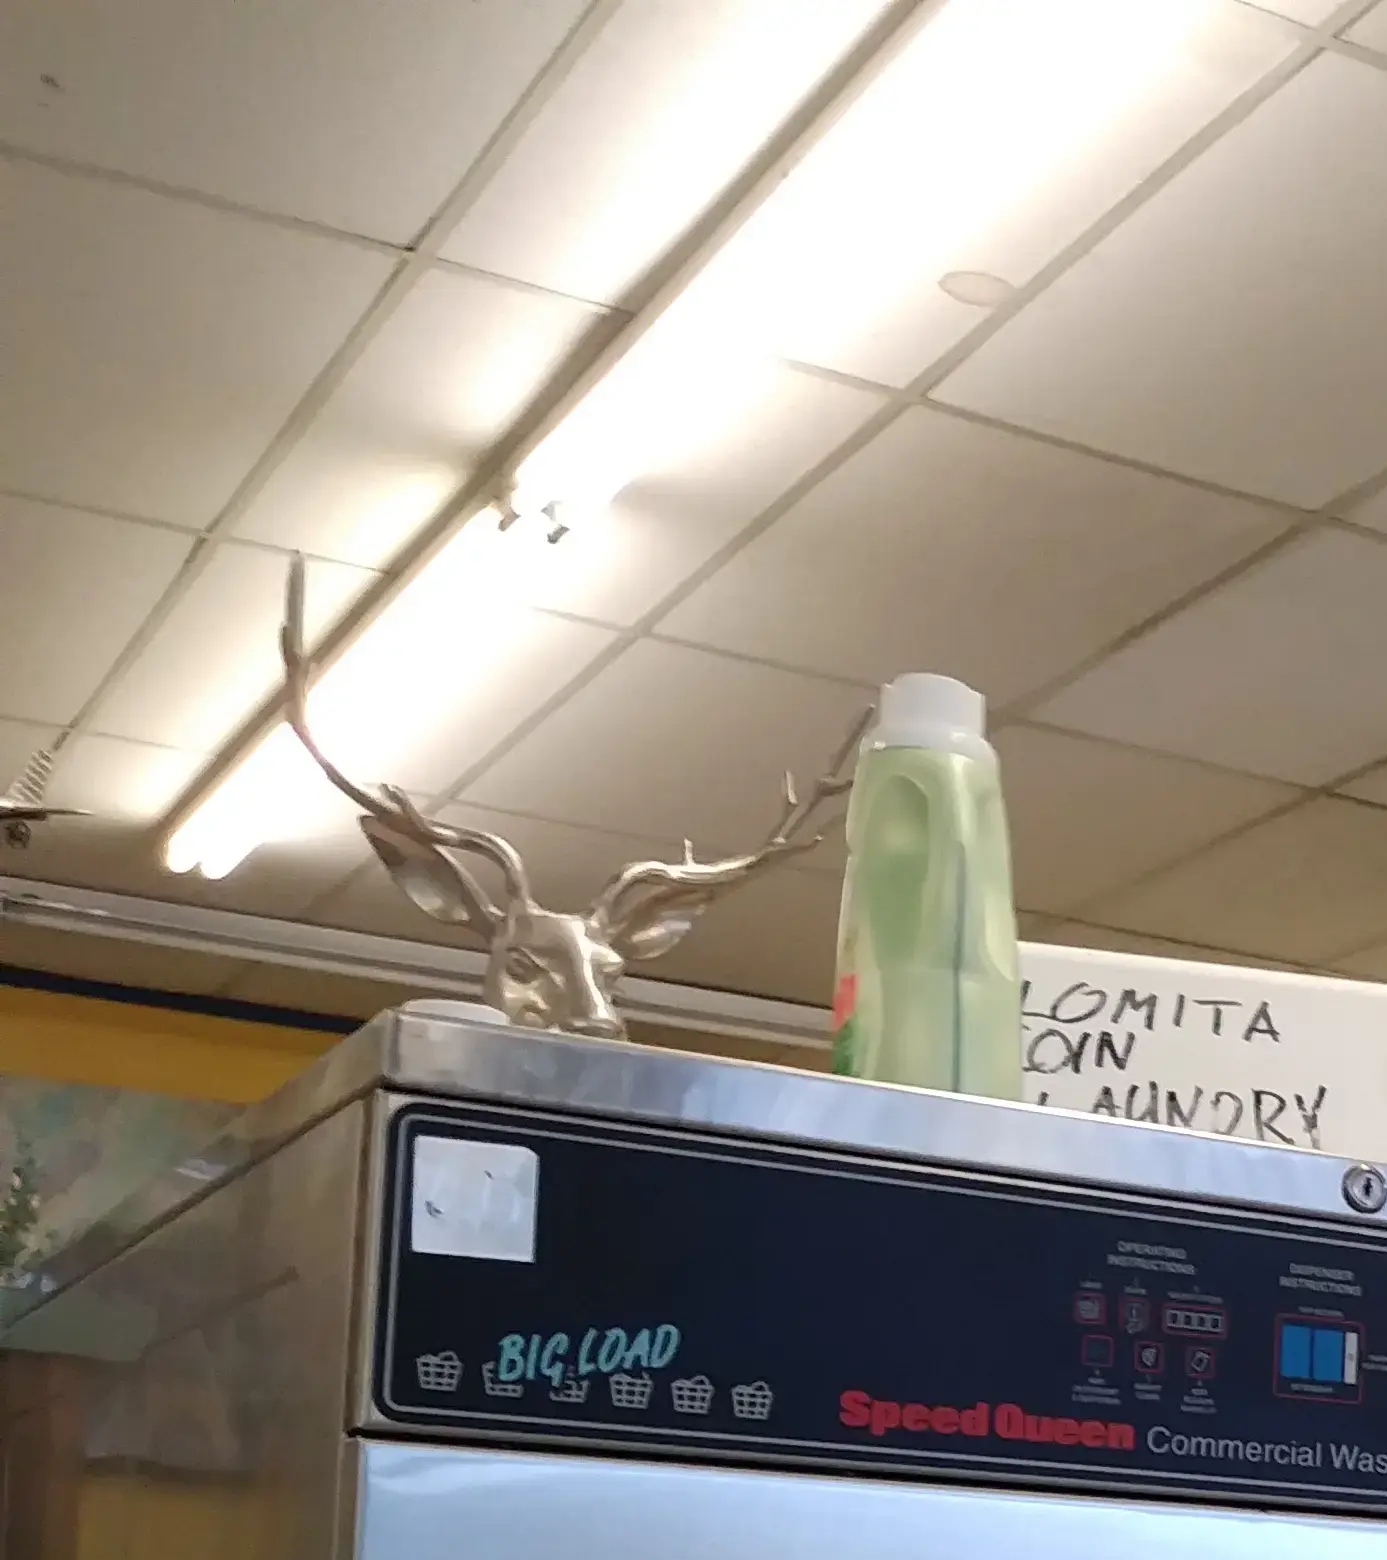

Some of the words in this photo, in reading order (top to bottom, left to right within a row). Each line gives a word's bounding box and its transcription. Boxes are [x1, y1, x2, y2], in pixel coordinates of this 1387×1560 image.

[1021, 980, 1281, 1043] LOMITA
[1037, 1081, 1328, 1150] AUNDRY
[499, 1332, 569, 1387] BIG
[579, 1323, 680, 1375] LOAD
[839, 1390, 990, 1437] Speed
[993, 1402, 1135, 1450] Queen
[1146, 1425, 1323, 1468] Commercial
